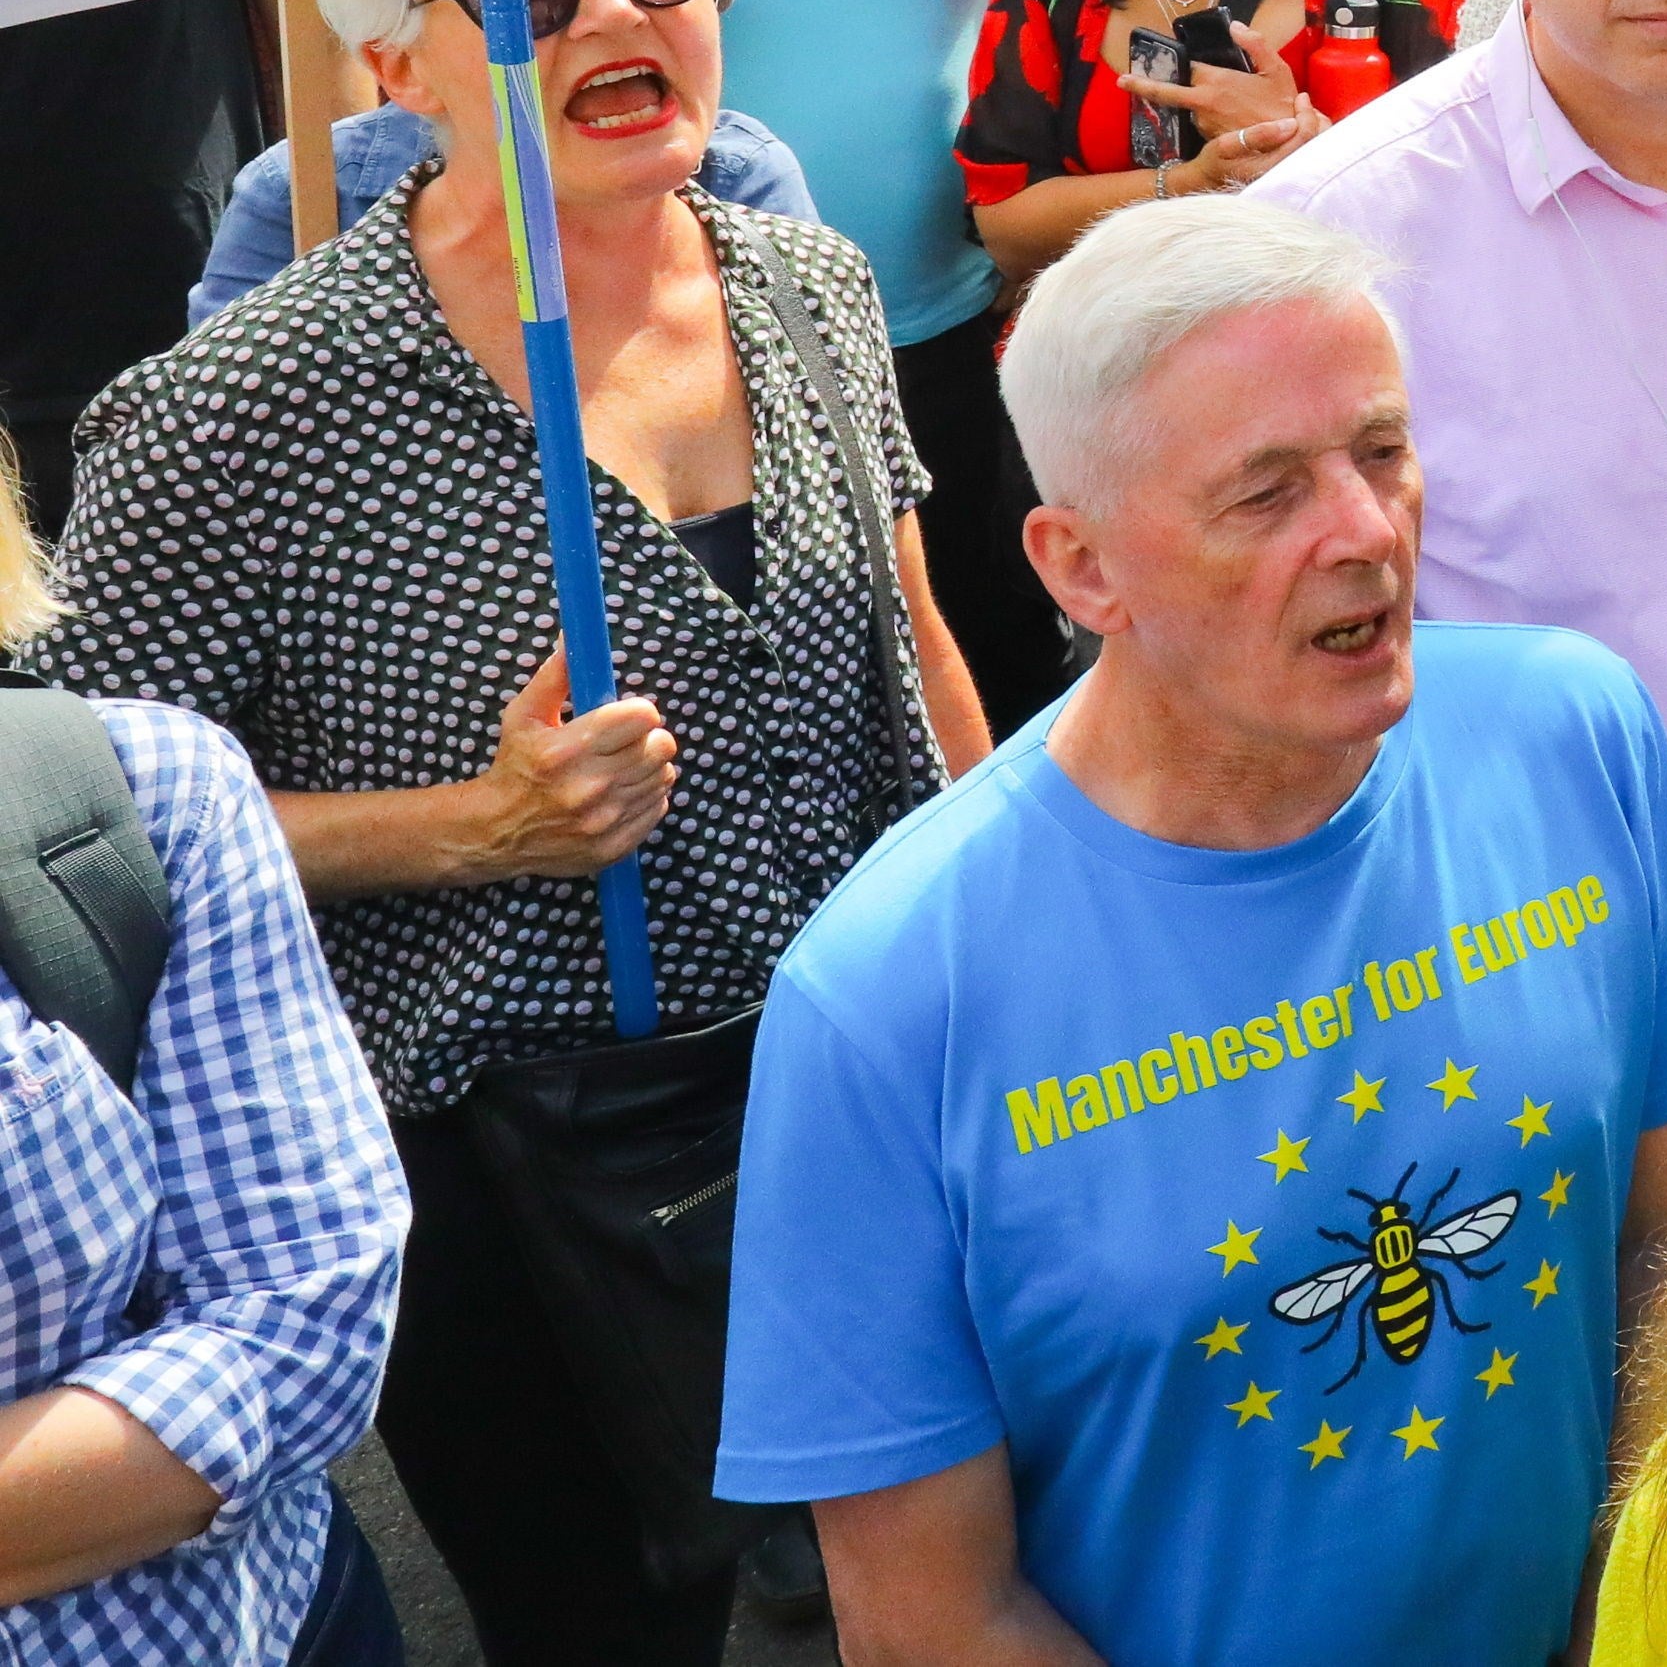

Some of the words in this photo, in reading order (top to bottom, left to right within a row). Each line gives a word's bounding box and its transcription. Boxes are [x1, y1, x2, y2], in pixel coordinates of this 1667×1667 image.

[1005, 986, 1357, 1156] Manchester
[1362, 948, 1443, 1024] for
[1448, 873, 1610, 986] Europe
